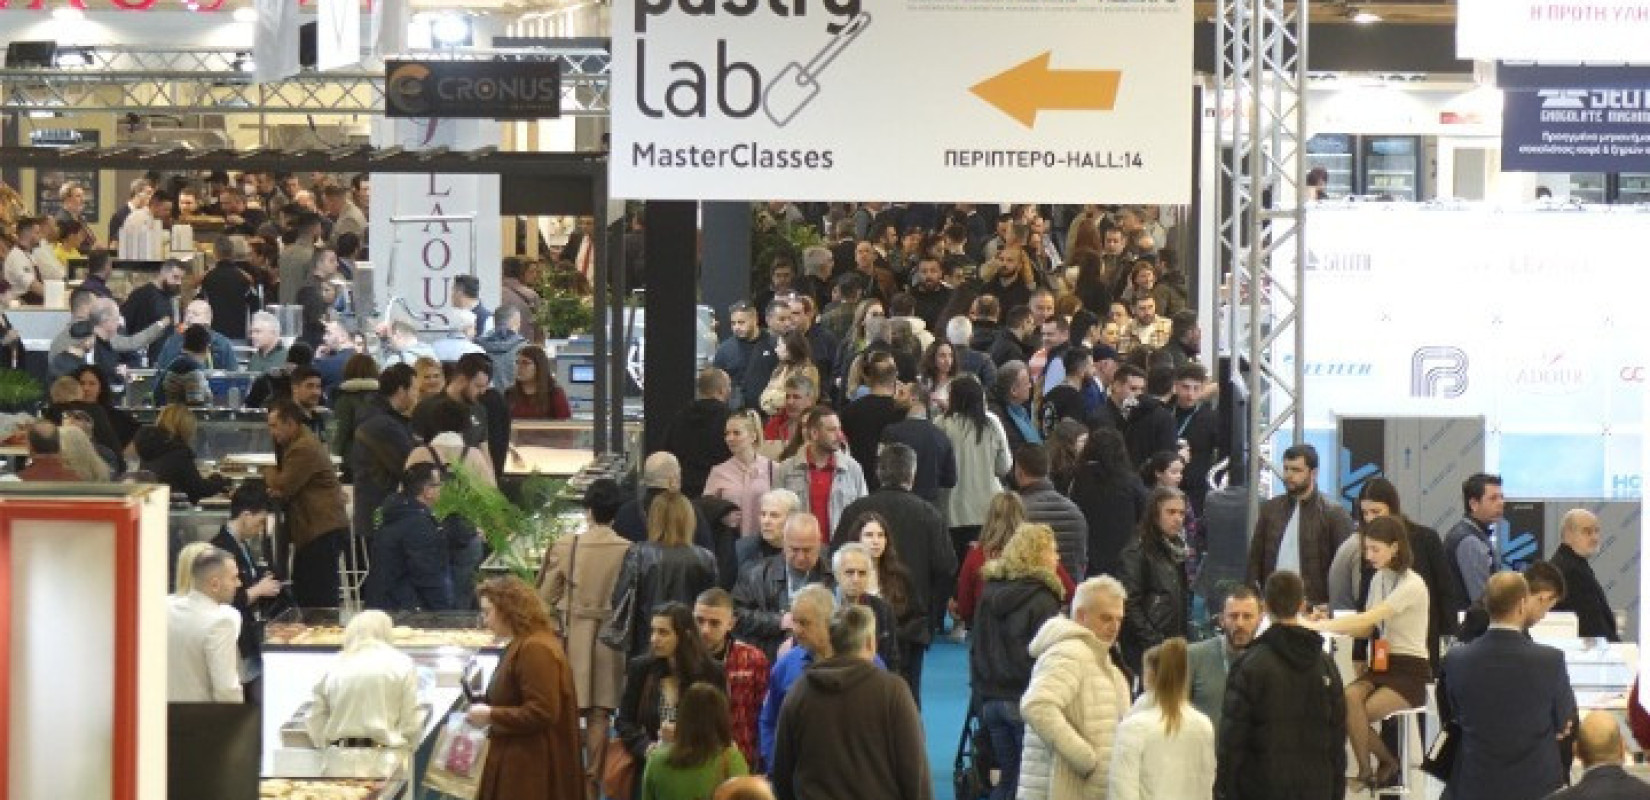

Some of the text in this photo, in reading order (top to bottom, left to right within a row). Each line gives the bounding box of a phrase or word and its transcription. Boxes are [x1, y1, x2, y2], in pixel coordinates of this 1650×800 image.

[437, 77, 556, 100] CRONUS
[636, 38, 762, 119] lab
[632, 142, 833, 169] MasterClasses
